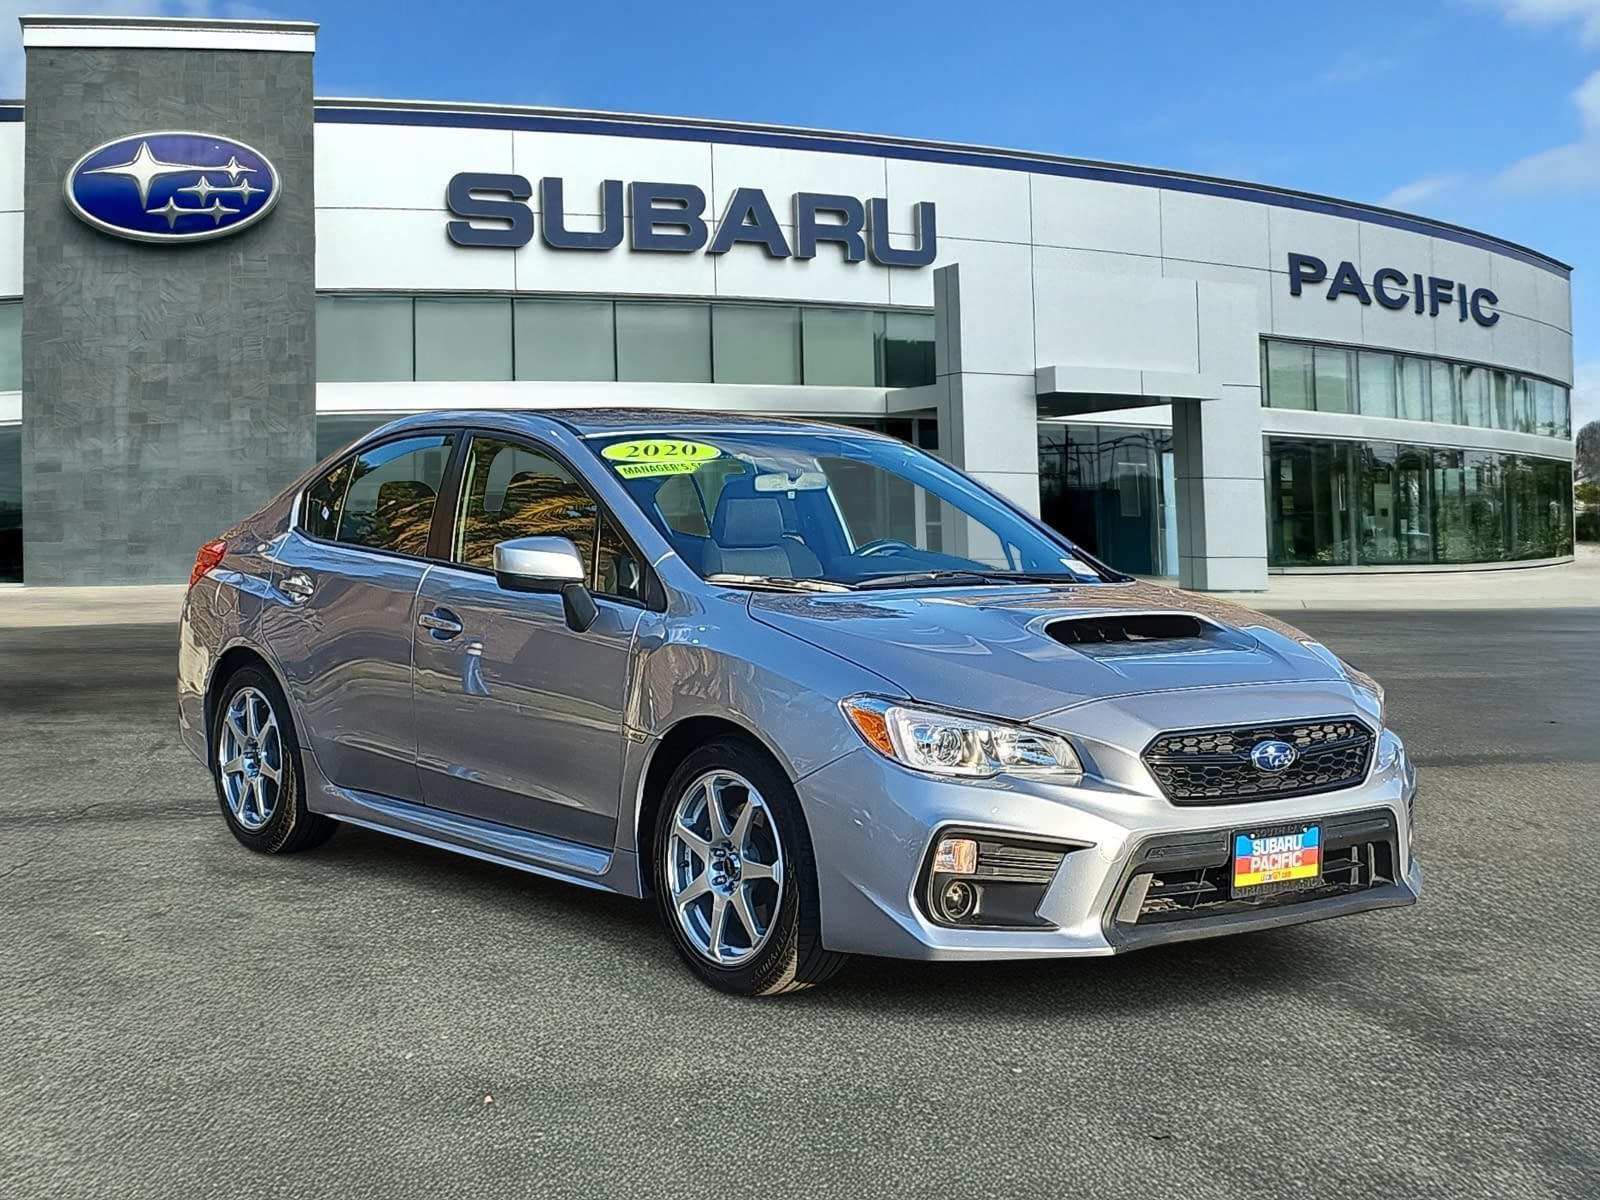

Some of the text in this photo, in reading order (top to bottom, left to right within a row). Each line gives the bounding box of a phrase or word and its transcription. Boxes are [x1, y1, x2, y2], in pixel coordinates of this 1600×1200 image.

[447, 172, 938, 268] SUBARU
[1288, 252, 1500, 327] PACIFIC
[625, 444, 698, 458] 2020
[622, 462, 690, 476] MANAGER'S
[1252, 834, 1304, 856] SUBARU
[1250, 851, 1304, 873] PACIFIC
